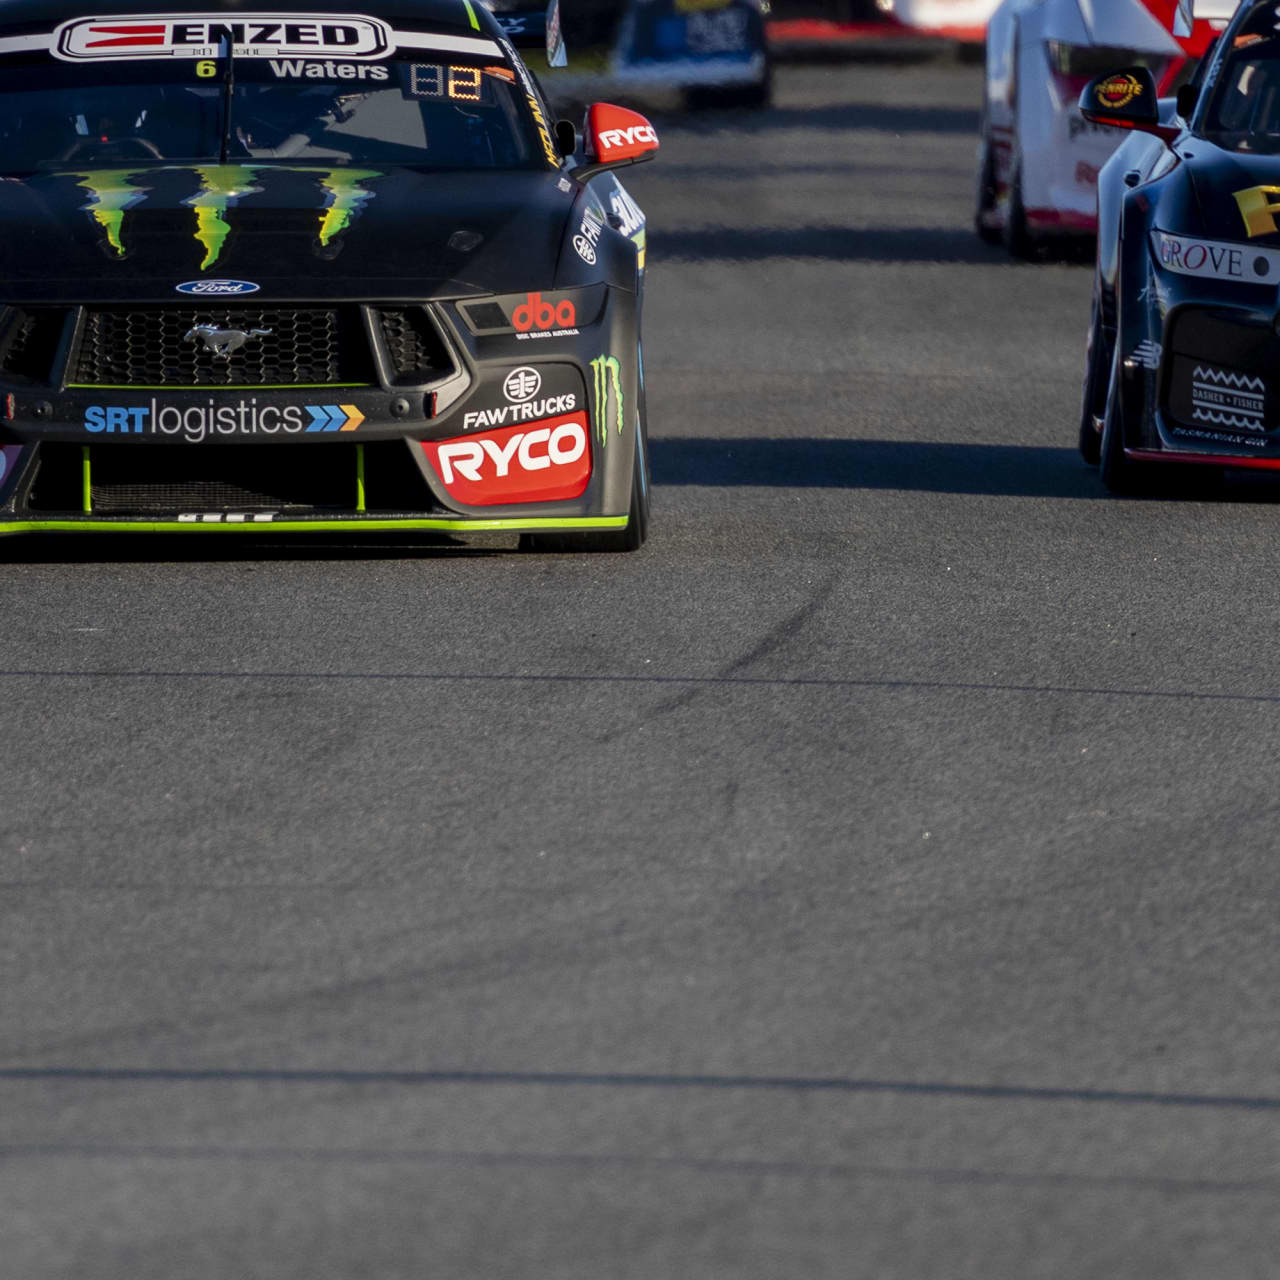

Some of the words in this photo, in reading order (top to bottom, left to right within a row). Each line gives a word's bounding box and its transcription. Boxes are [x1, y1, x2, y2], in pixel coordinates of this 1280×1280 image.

[171, 23, 360, 46] ENZED
[195, 59, 217, 78] 6
[268, 59, 390, 81] Waters
[597, 123, 659, 149] RYCO
[191, 280, 243, 294] Ford
[511, 291, 576, 332] dba
[1192, 388, 1225, 404] DASHER
[1232, 396, 1264, 411] FISHER
[463, 407, 510, 430] FAW
[508, 393, 576, 422] TRUCKS
[437, 422, 586, 485] RYCO
